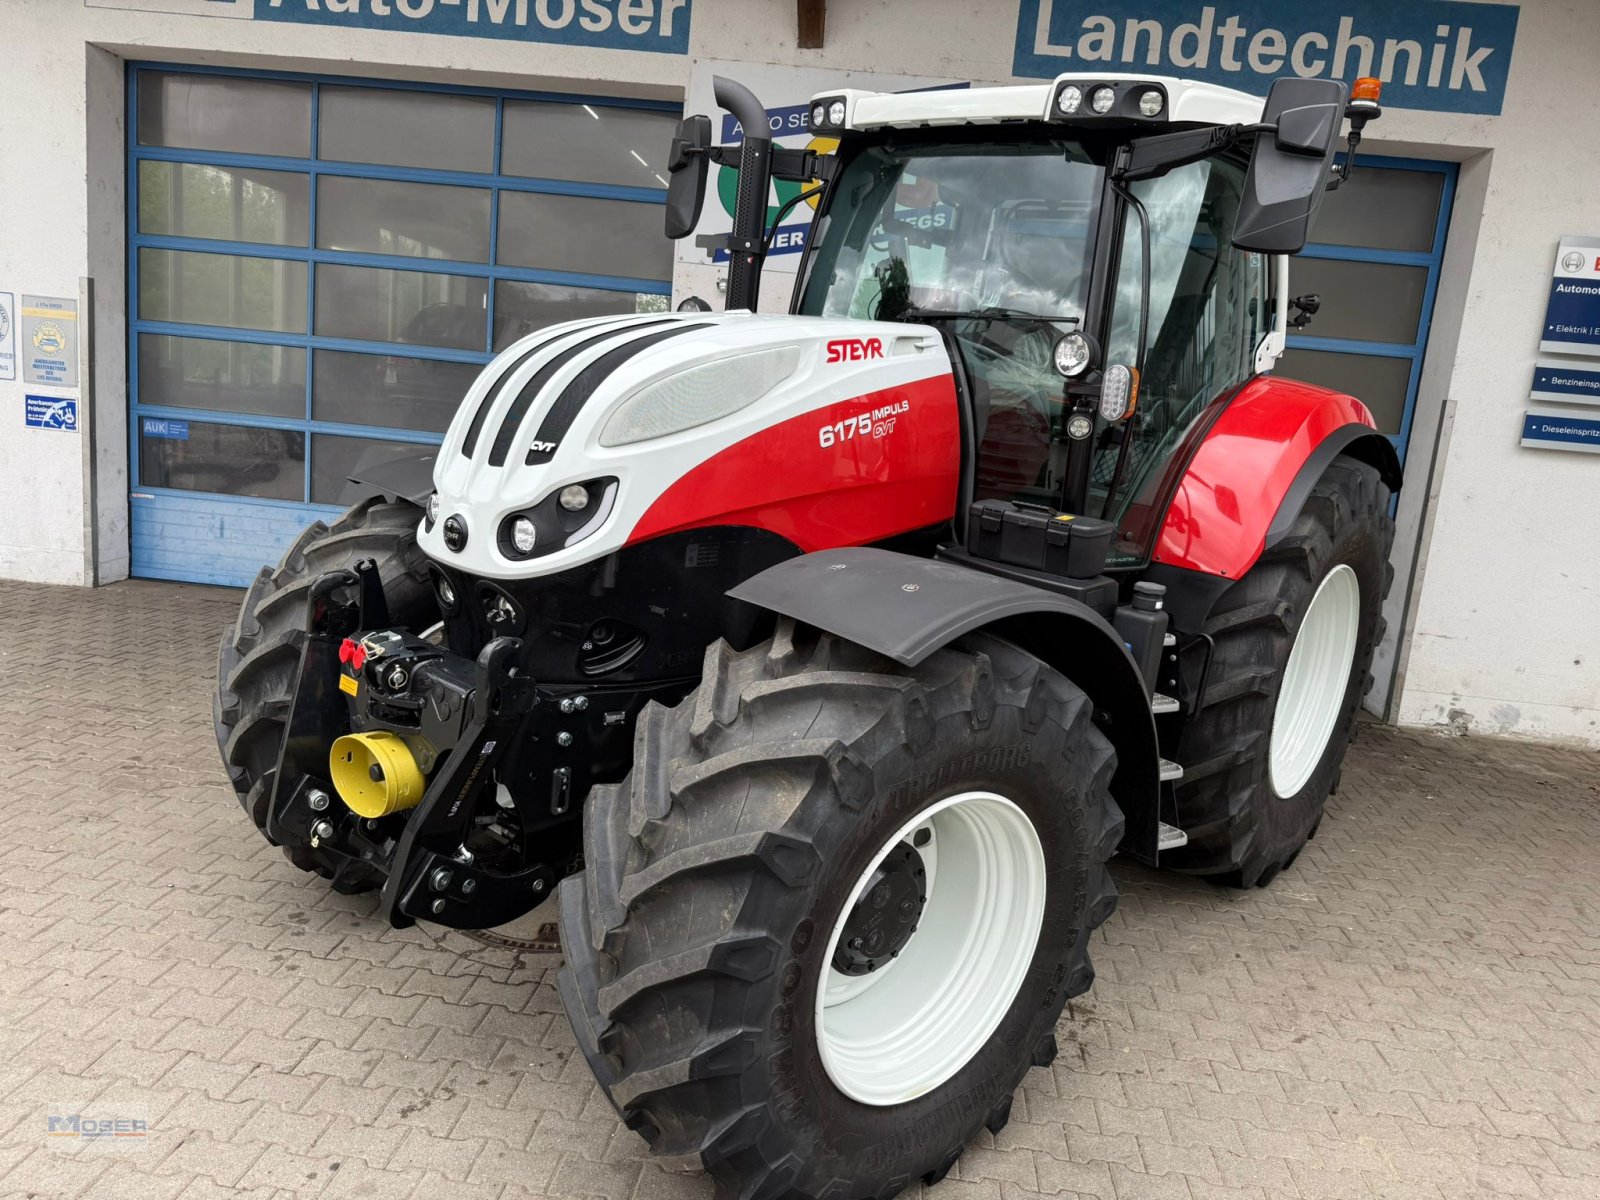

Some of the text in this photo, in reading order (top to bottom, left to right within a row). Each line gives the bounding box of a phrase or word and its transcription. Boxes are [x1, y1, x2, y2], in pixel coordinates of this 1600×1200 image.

[269, 0, 686, 37] o-Moser
[1033, 0, 1494, 92] Landtechnik
[1555, 324, 1588, 335] Elektrik
[826, 337, 884, 363] STEYR
[819, 400, 910, 449] 6175 IMPULS
[530, 440, 556, 452] CVT
